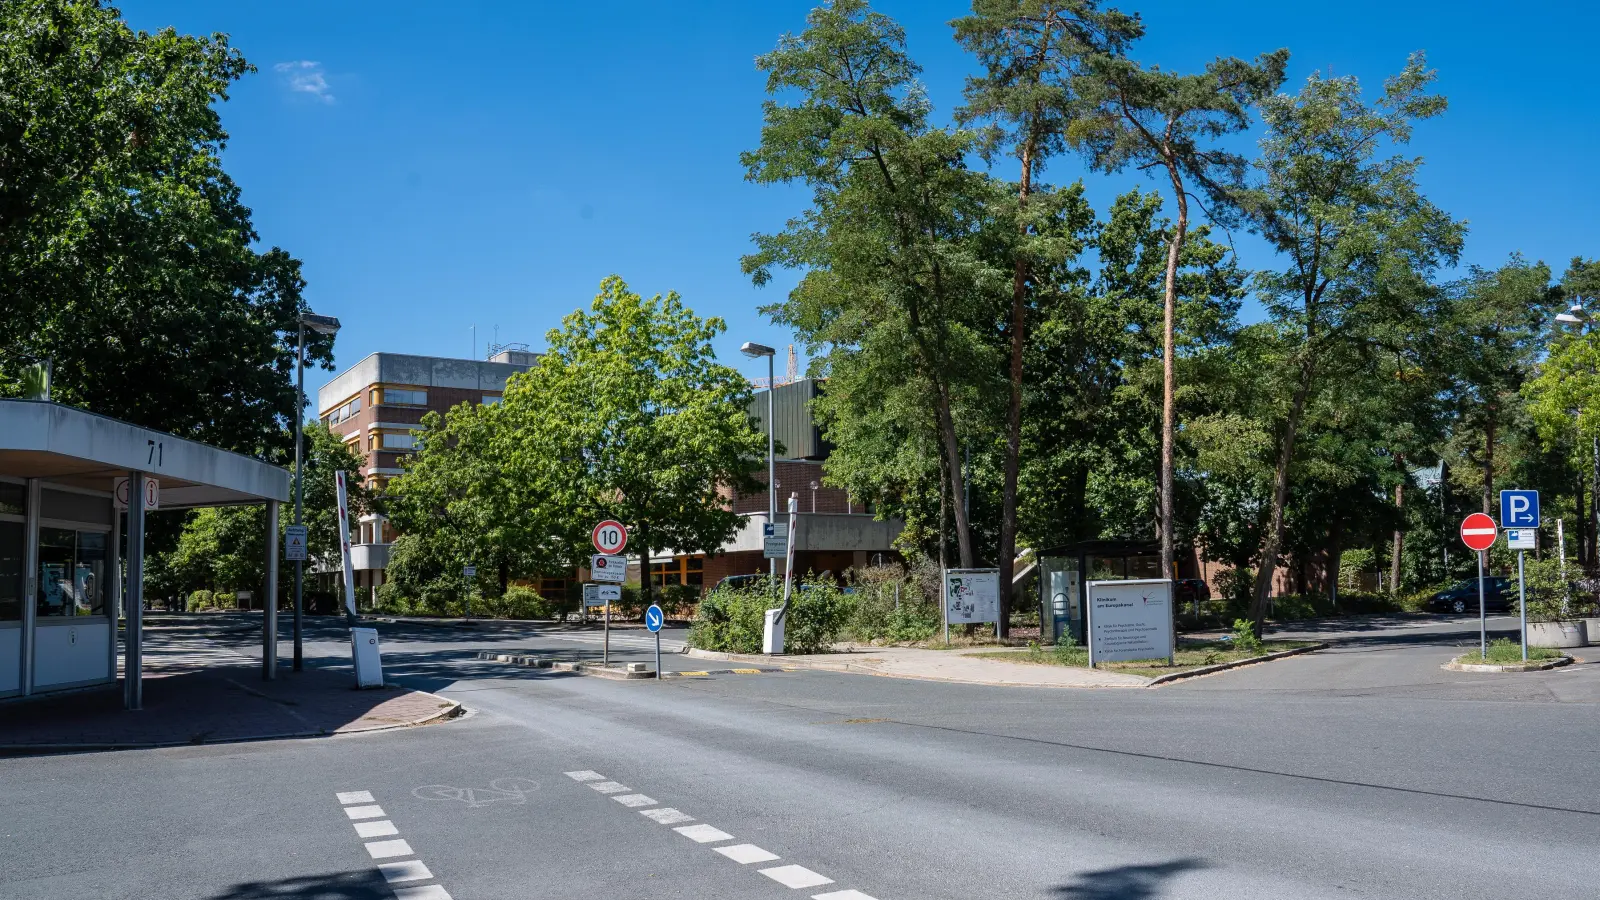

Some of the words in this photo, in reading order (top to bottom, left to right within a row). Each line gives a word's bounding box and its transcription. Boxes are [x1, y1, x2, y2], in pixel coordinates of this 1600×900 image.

[148, 440, 162, 467] 71
[1510, 496, 1530, 522] P
[602, 530, 618, 545] 10
